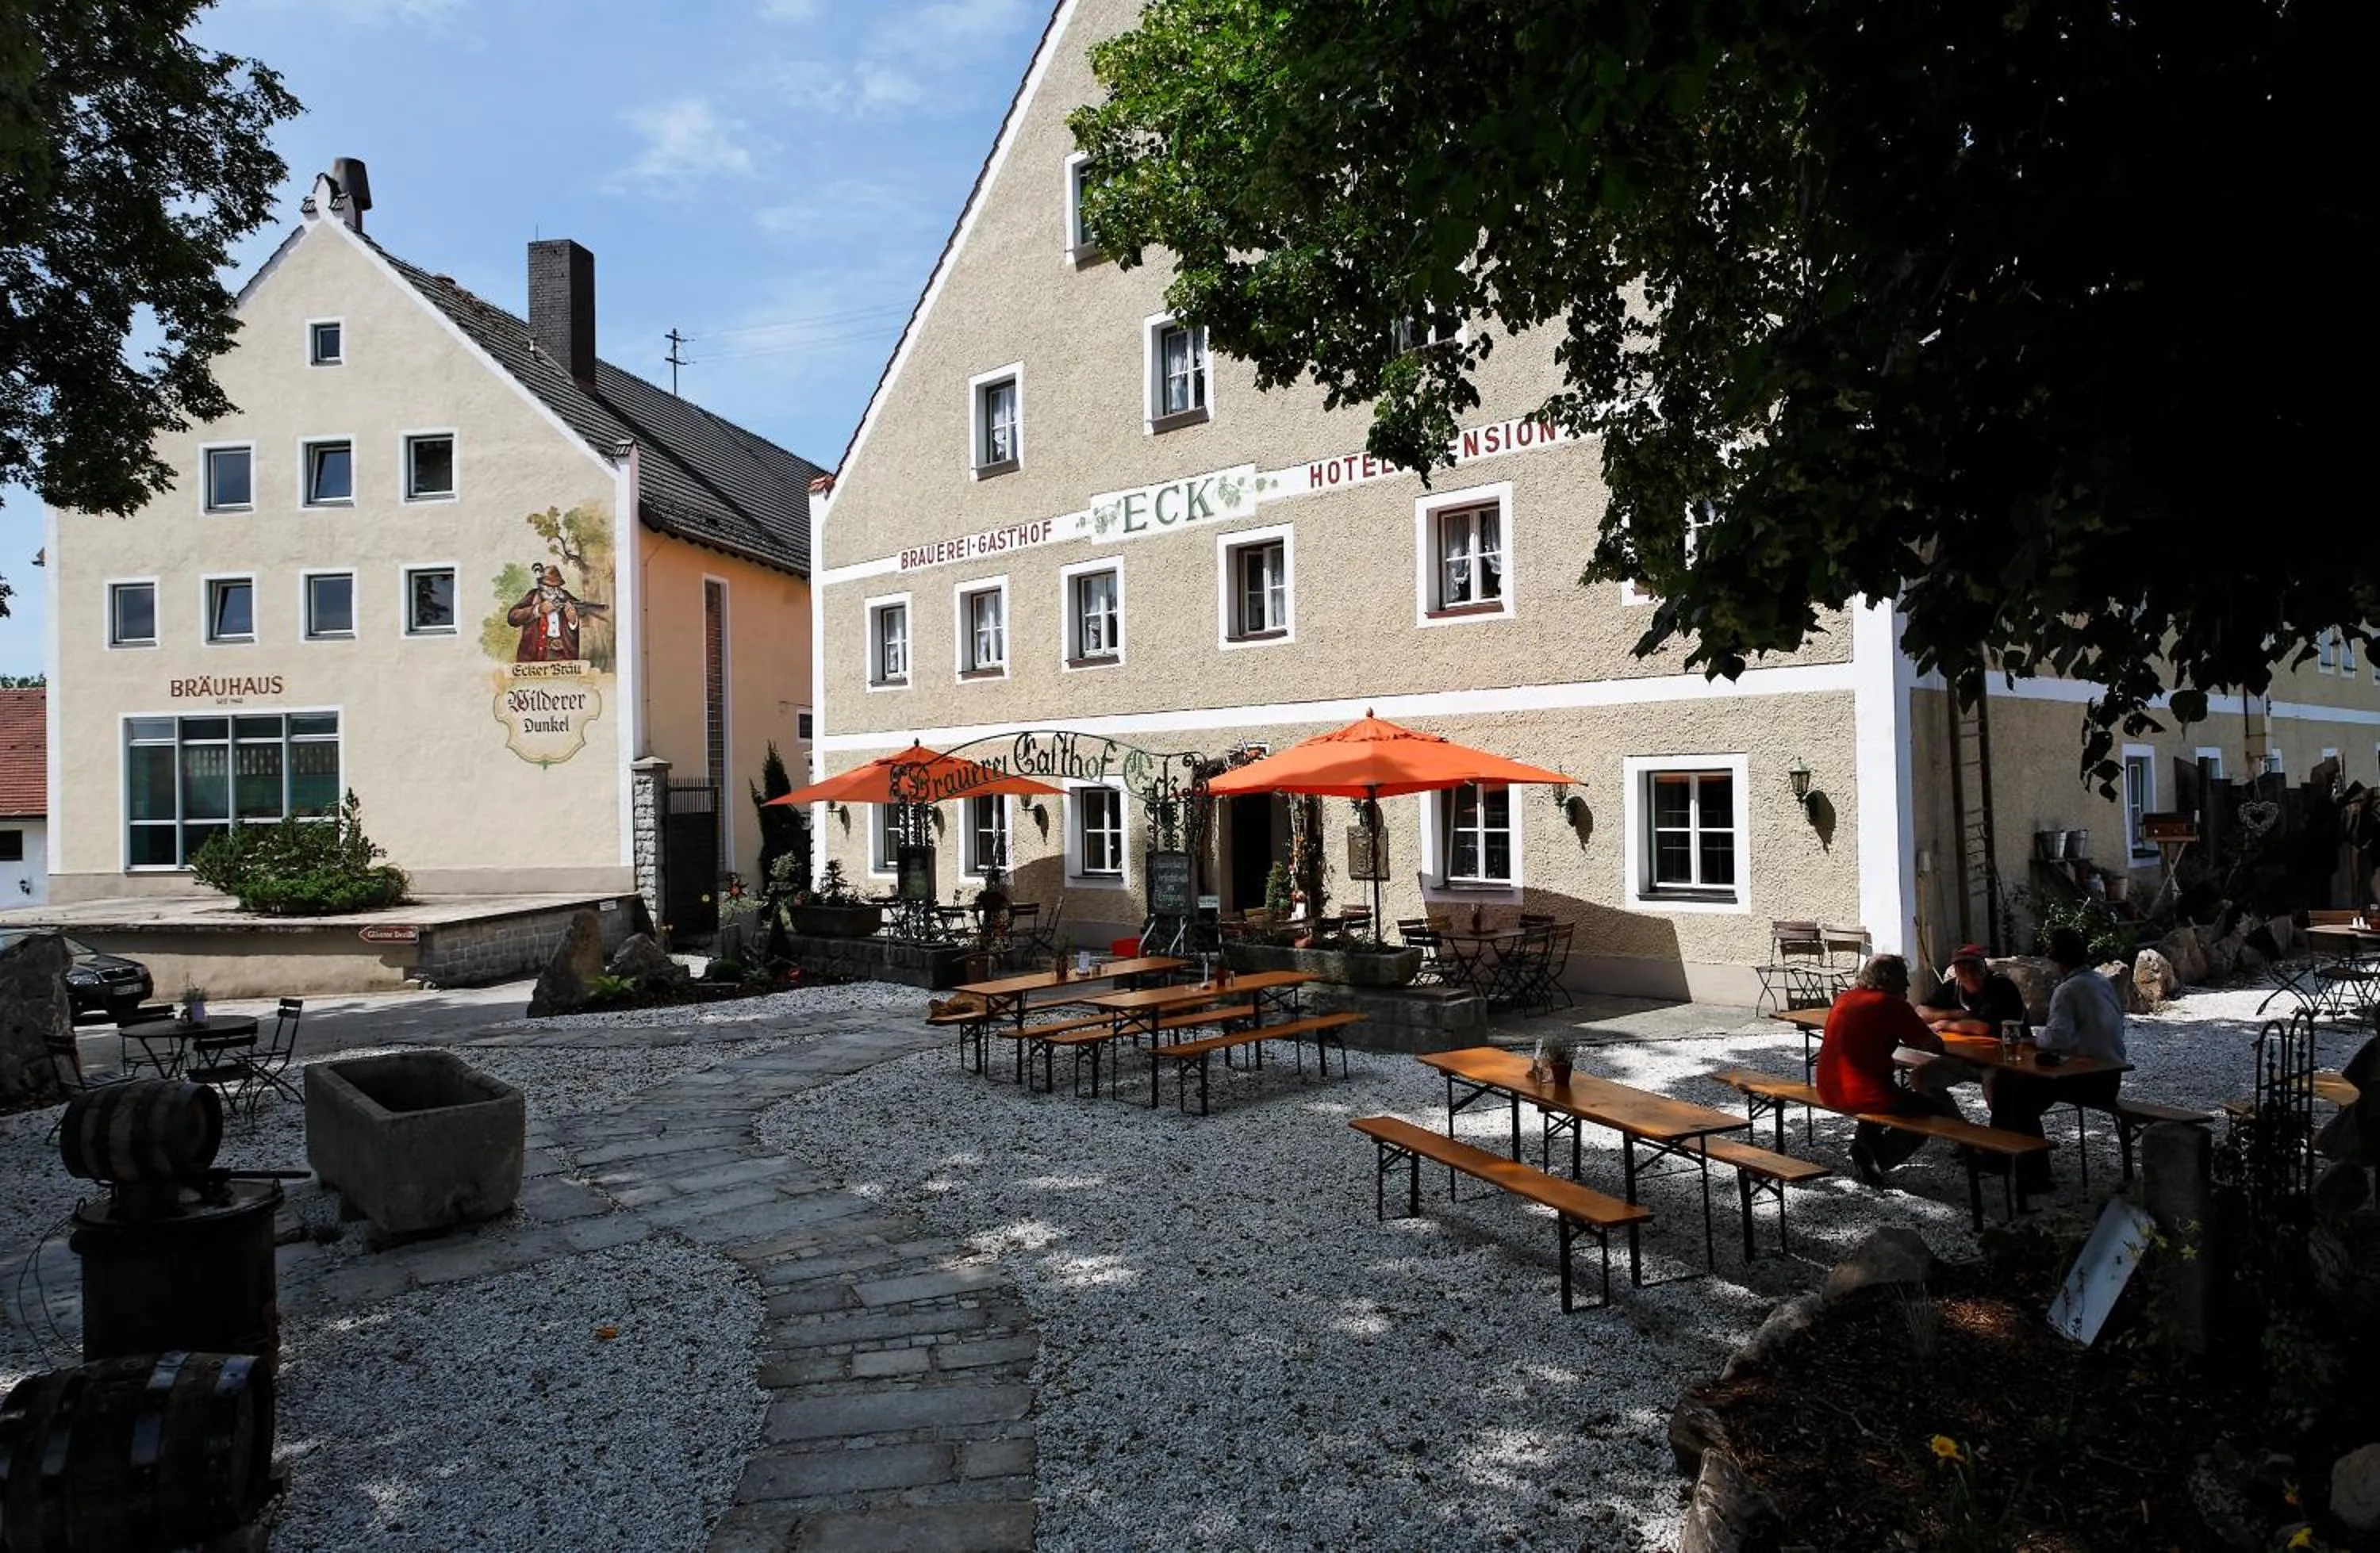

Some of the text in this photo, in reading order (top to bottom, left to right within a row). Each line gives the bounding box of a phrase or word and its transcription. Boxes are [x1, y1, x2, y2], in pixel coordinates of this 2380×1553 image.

[1123, 477, 1215, 533] ECK
[512, 662, 582, 677] Ecker Bräu
[171, 675, 283, 697] BRÄUHAUS
[507, 688, 586, 712] Wilderer
[523, 715, 570, 733] Dunkel
